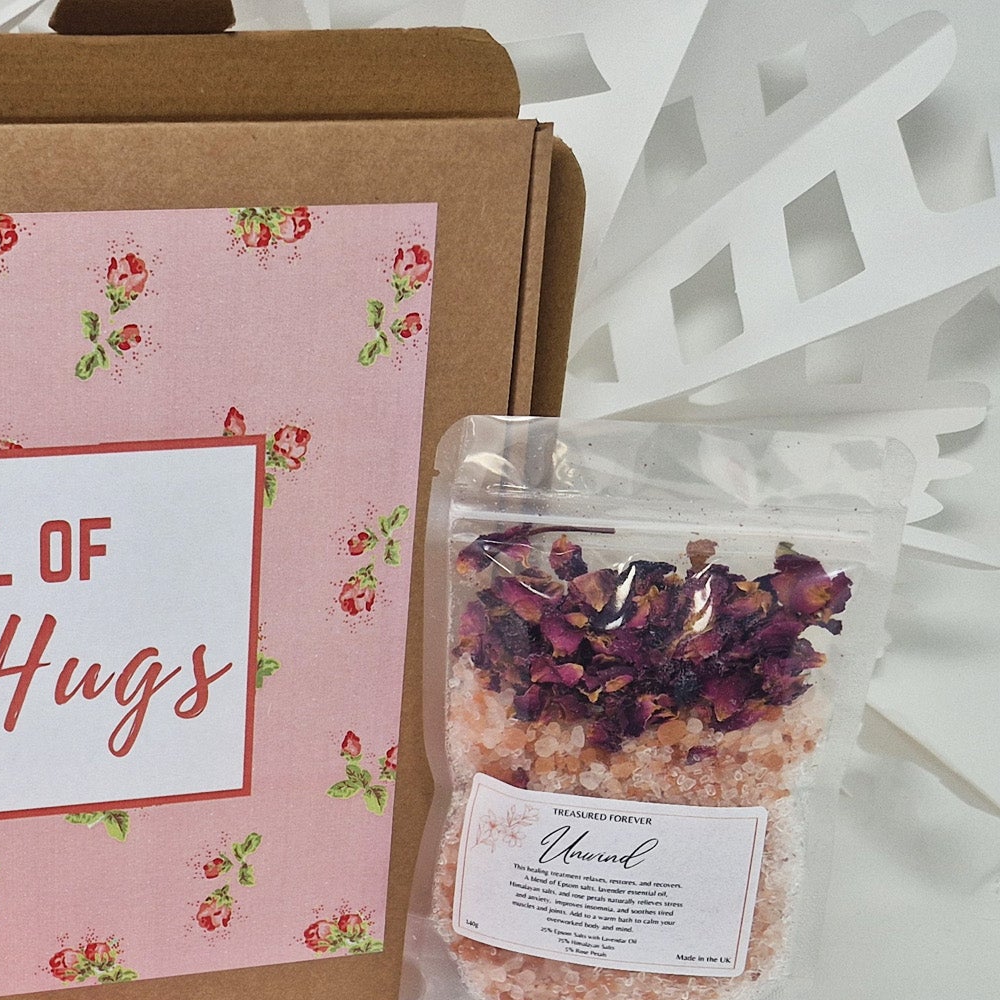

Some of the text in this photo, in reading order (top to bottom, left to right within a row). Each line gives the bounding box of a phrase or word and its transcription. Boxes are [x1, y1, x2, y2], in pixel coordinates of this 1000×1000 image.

[39, 517, 112, 583] OF
[553, 808, 652, 825] TREASURED FOREVER
[538, 825, 659, 869] Unwind
[527, 866, 549, 876] healing
[550, 871, 581, 880] treatment
[530, 876, 548, 884] blend
[557, 881, 578, 889] Epsom
[512, 901, 535, 909] muscles
[555, 900, 583, 909] improves
[607, 897, 635, 905] naturally
[637, 899, 662, 907] relieves
[546, 917, 583, 927] overworked
[584, 922, 599, 930] body
